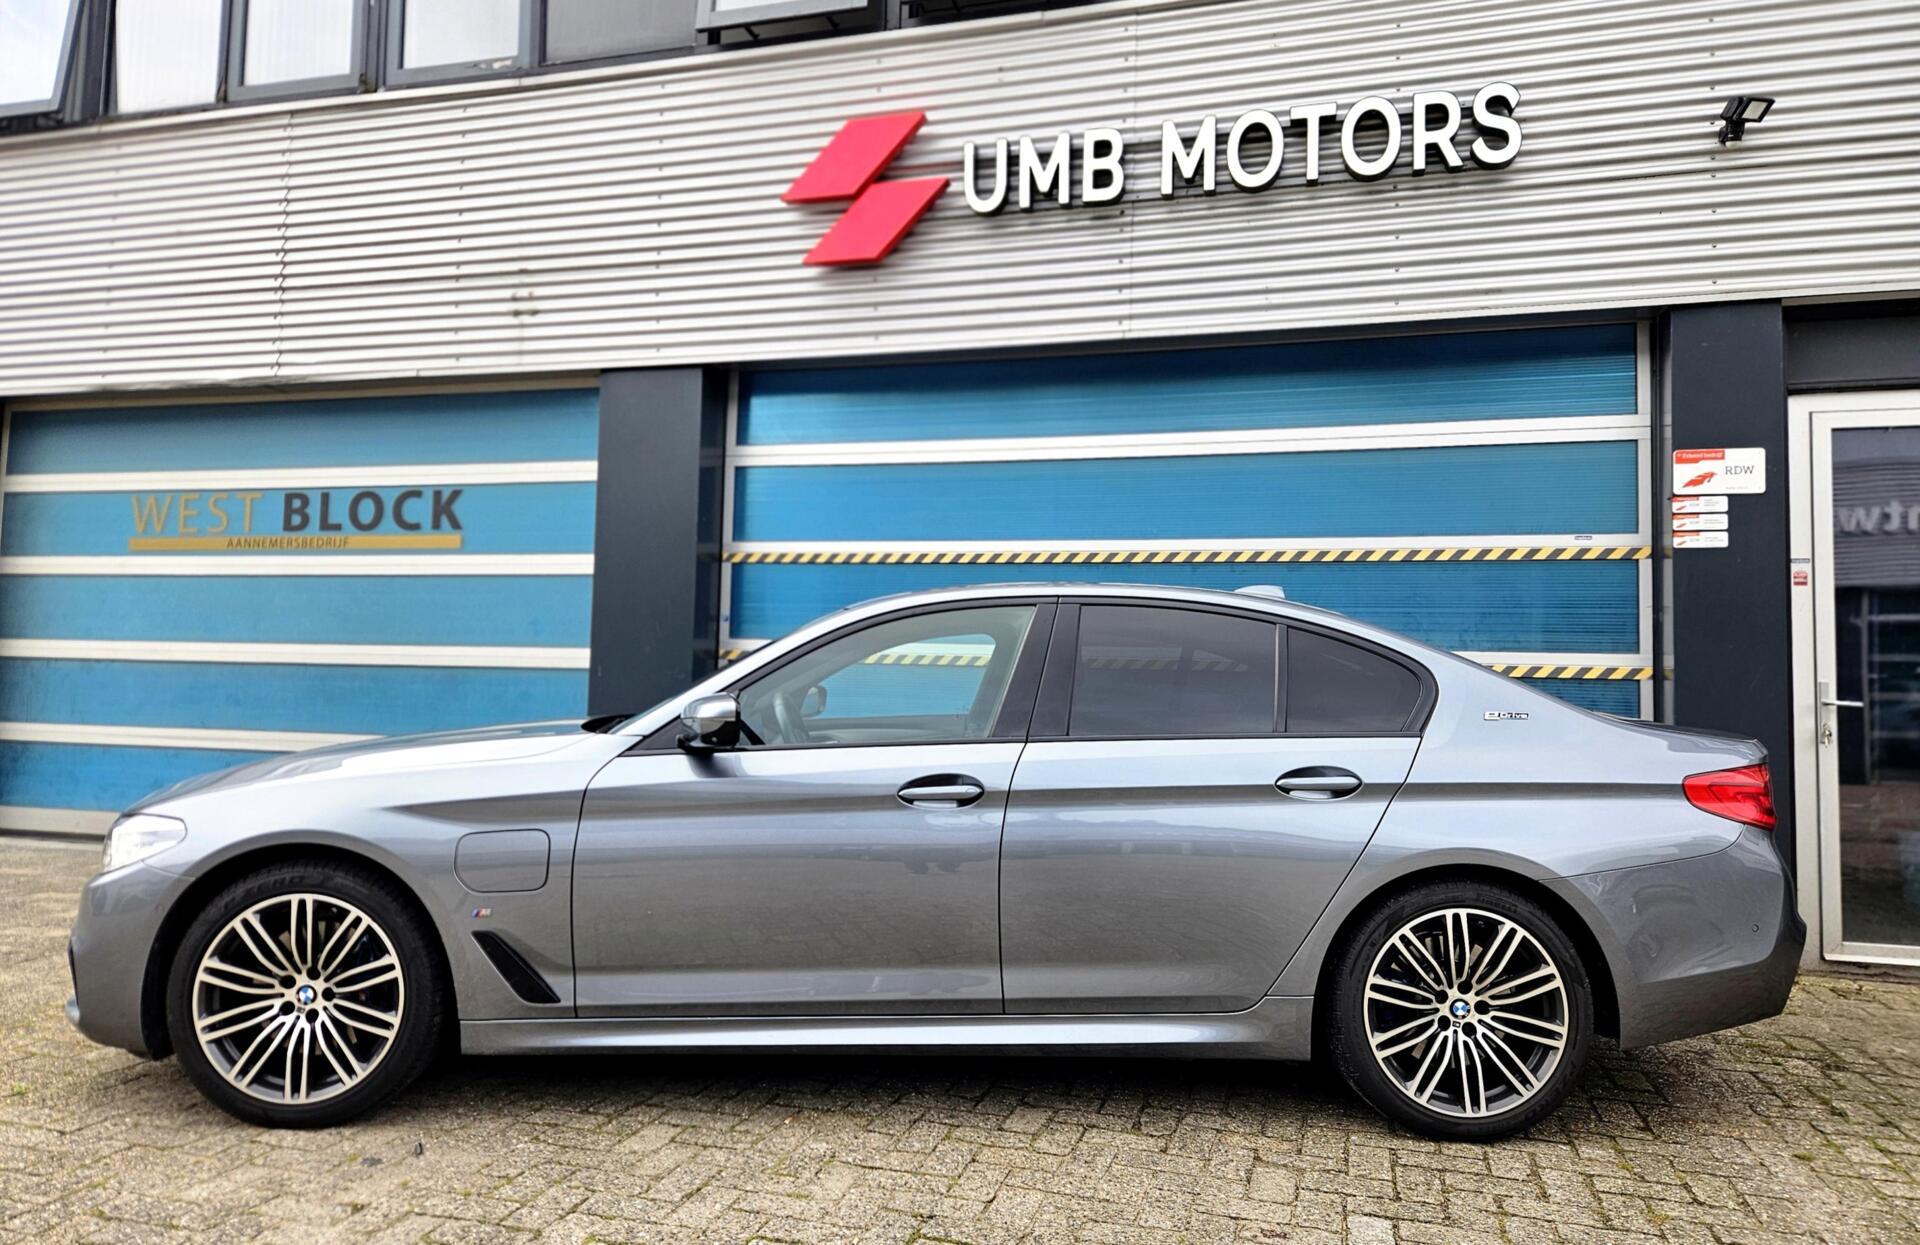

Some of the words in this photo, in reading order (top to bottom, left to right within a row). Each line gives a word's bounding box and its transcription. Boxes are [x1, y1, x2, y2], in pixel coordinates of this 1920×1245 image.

[962, 127, 1126, 216] UMB
[1160, 82, 1524, 199] MOTORS
[1724, 464, 1755, 476] RDW
[130, 491, 264, 535] WEST
[282, 488, 465, 533] BLOCK
[225, 535, 352, 550] AANNEMERSBEDRIJF
